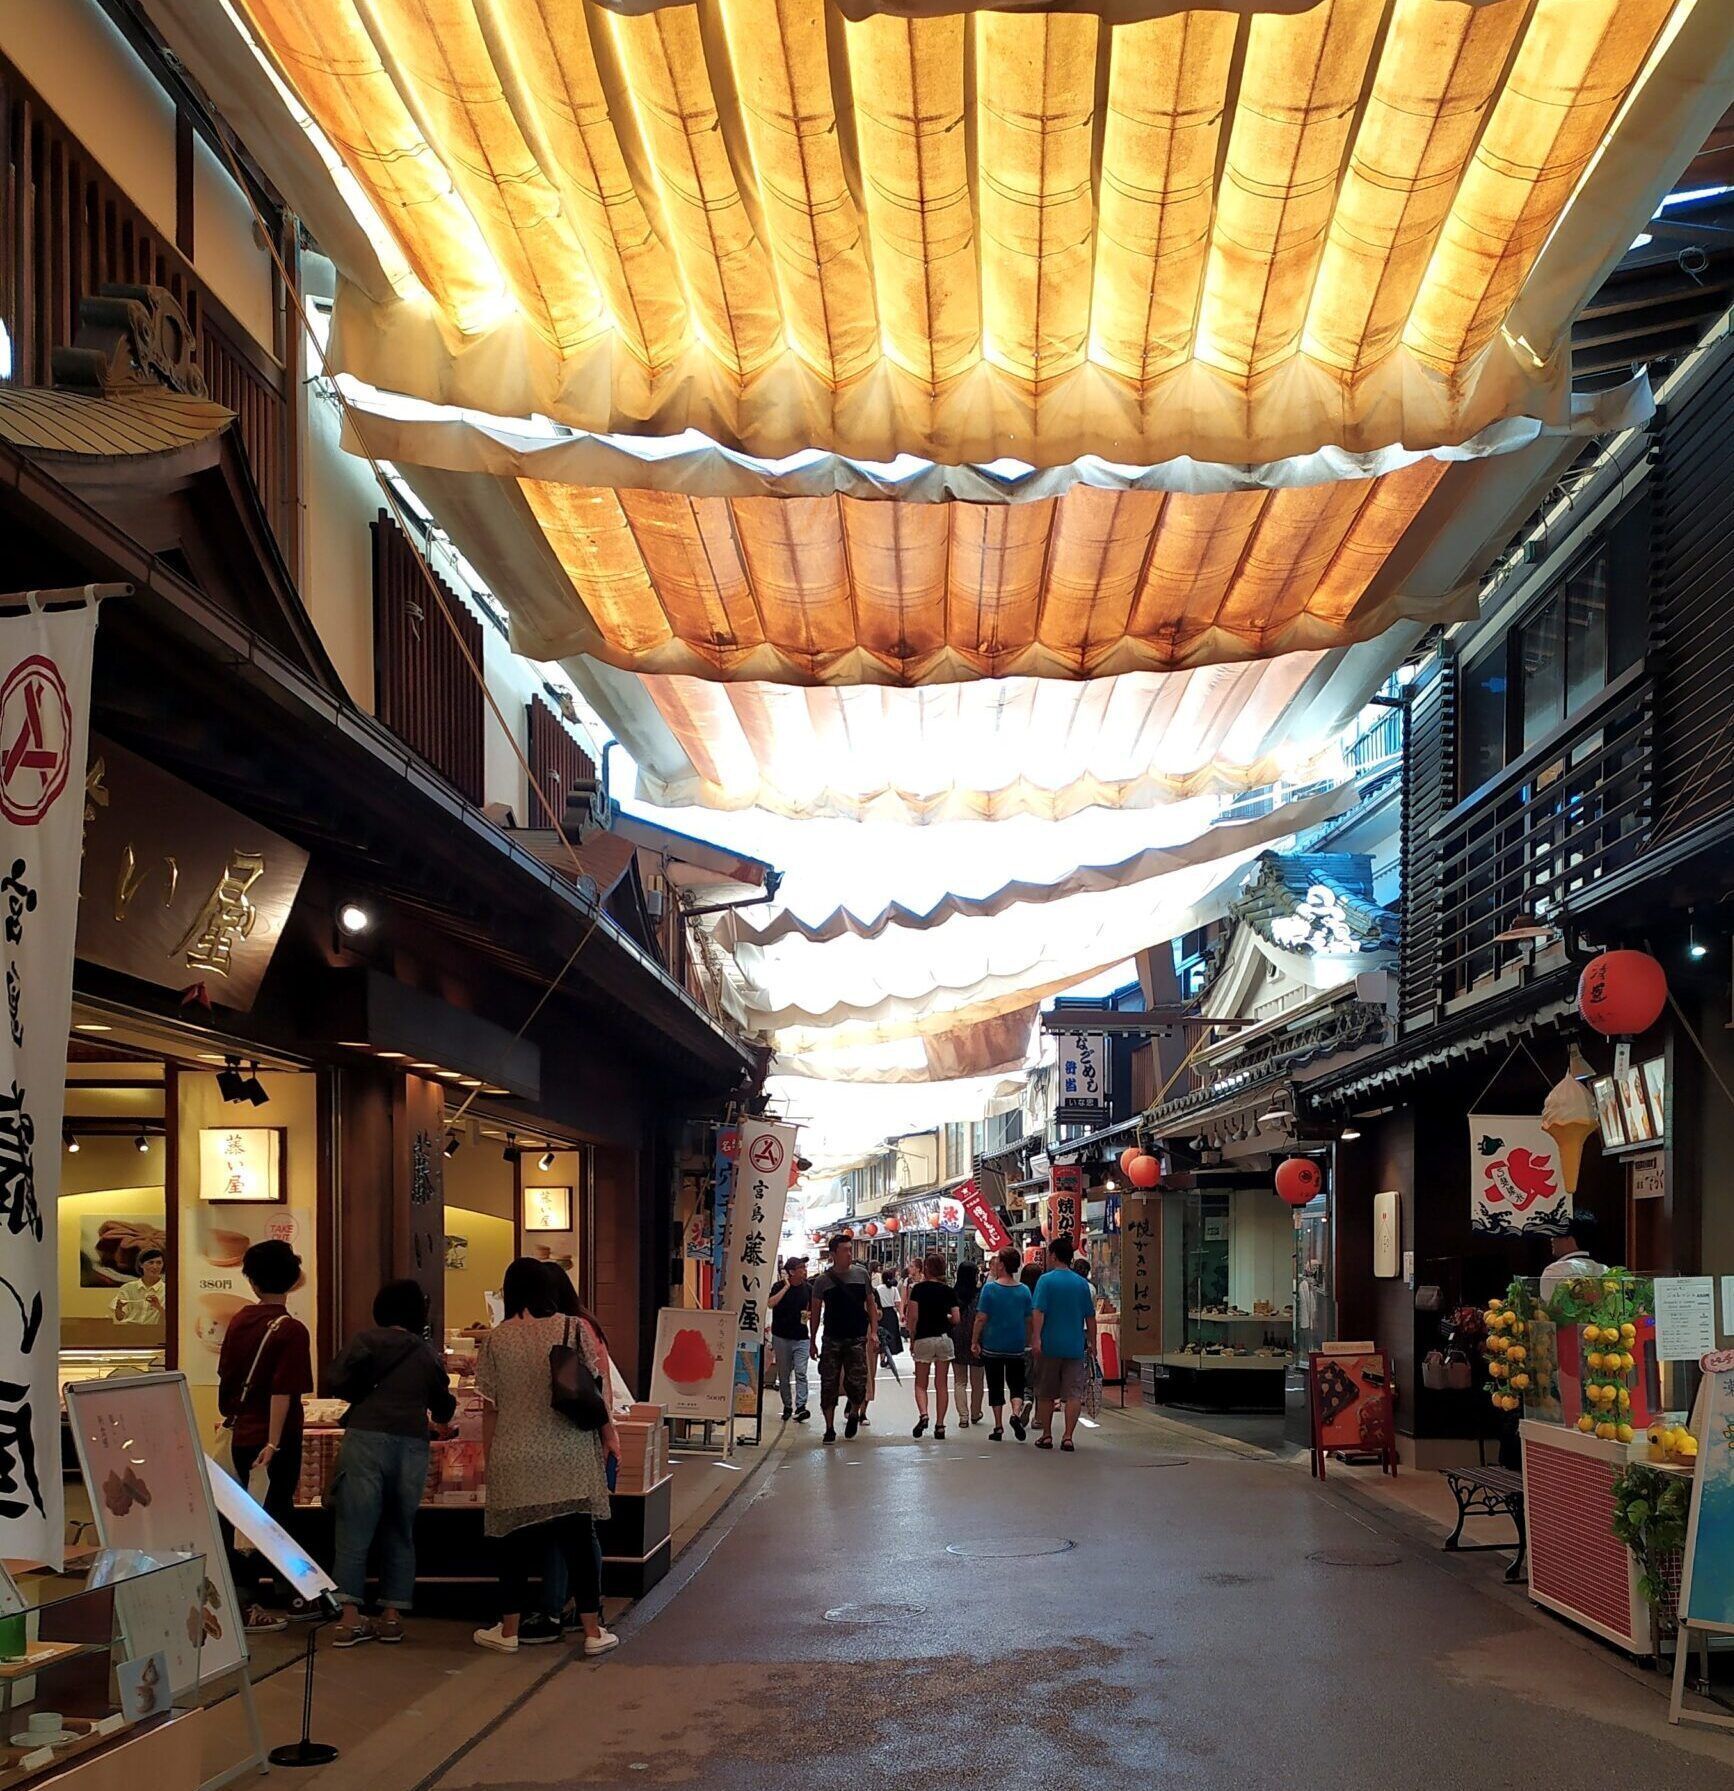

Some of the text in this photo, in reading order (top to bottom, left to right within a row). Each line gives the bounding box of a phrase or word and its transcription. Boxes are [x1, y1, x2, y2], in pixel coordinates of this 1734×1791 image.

[1073, 1032, 1099, 1093] なごめし
[224, 1134, 246, 1194] 藤い屋
[270, 1224, 294, 1233] TAKE
[740, 1180, 769, 1333] 宮島藤い屋
[200, 1280, 232, 1289] 380円
